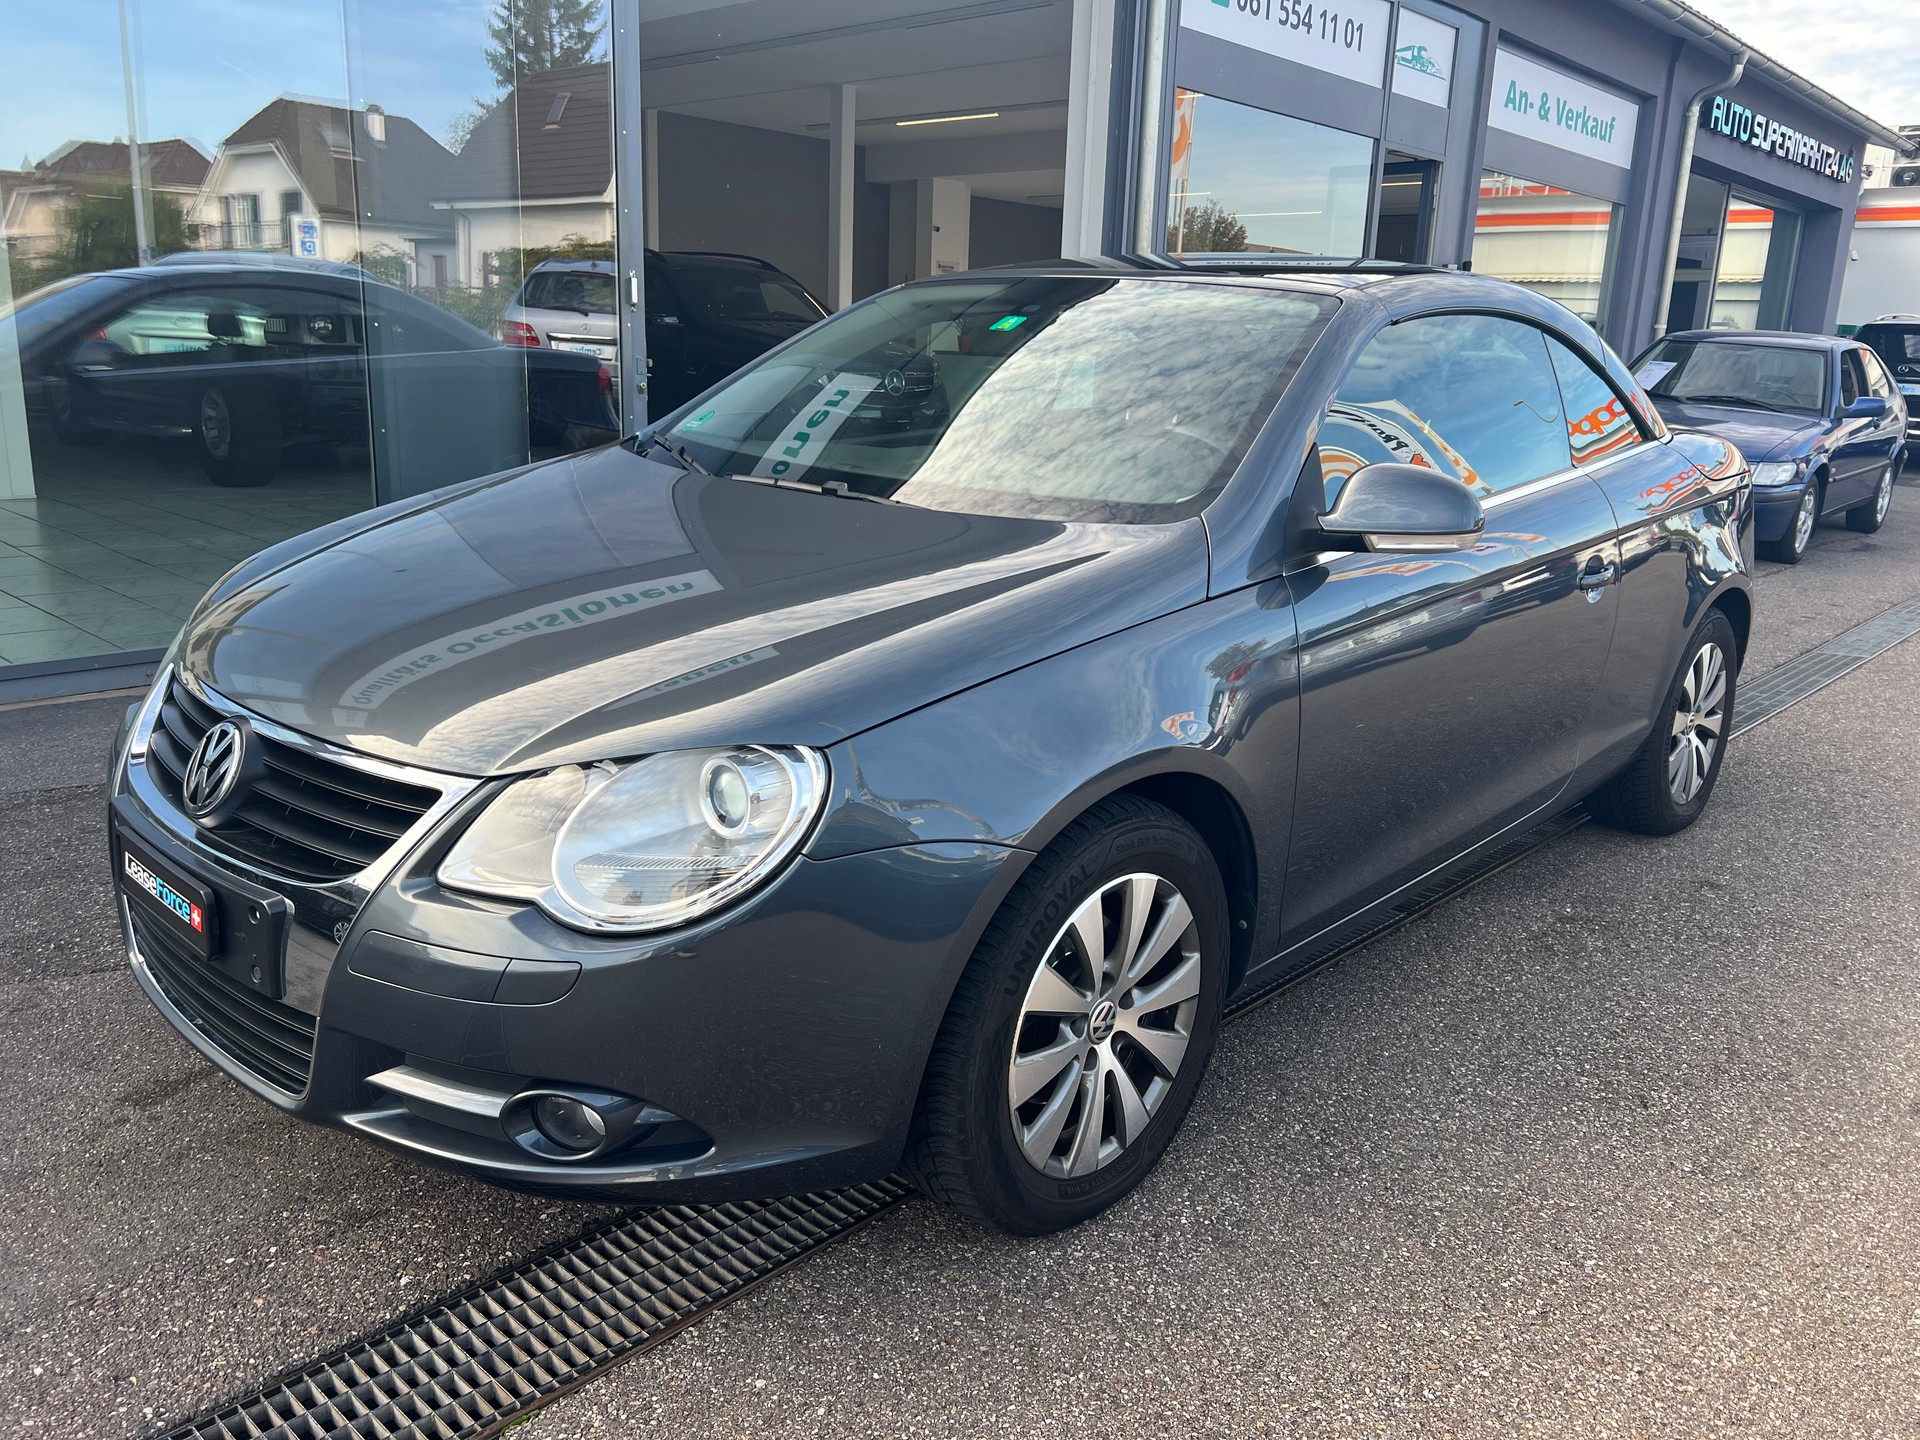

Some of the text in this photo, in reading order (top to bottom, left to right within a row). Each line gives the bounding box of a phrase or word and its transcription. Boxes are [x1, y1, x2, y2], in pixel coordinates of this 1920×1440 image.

[1278, 0, 1313, 35] 554
[1319, 9, 1339, 44] 11
[1344, 18, 1364, 52] 01
[1504, 79, 1616, 143] An- & Verkauf
[1710, 95, 1854, 184] AUTO SUPERMARKT24 AG
[125, 851, 191, 921] LeaseForce
[1003, 864, 1095, 997] UNIROYAL
